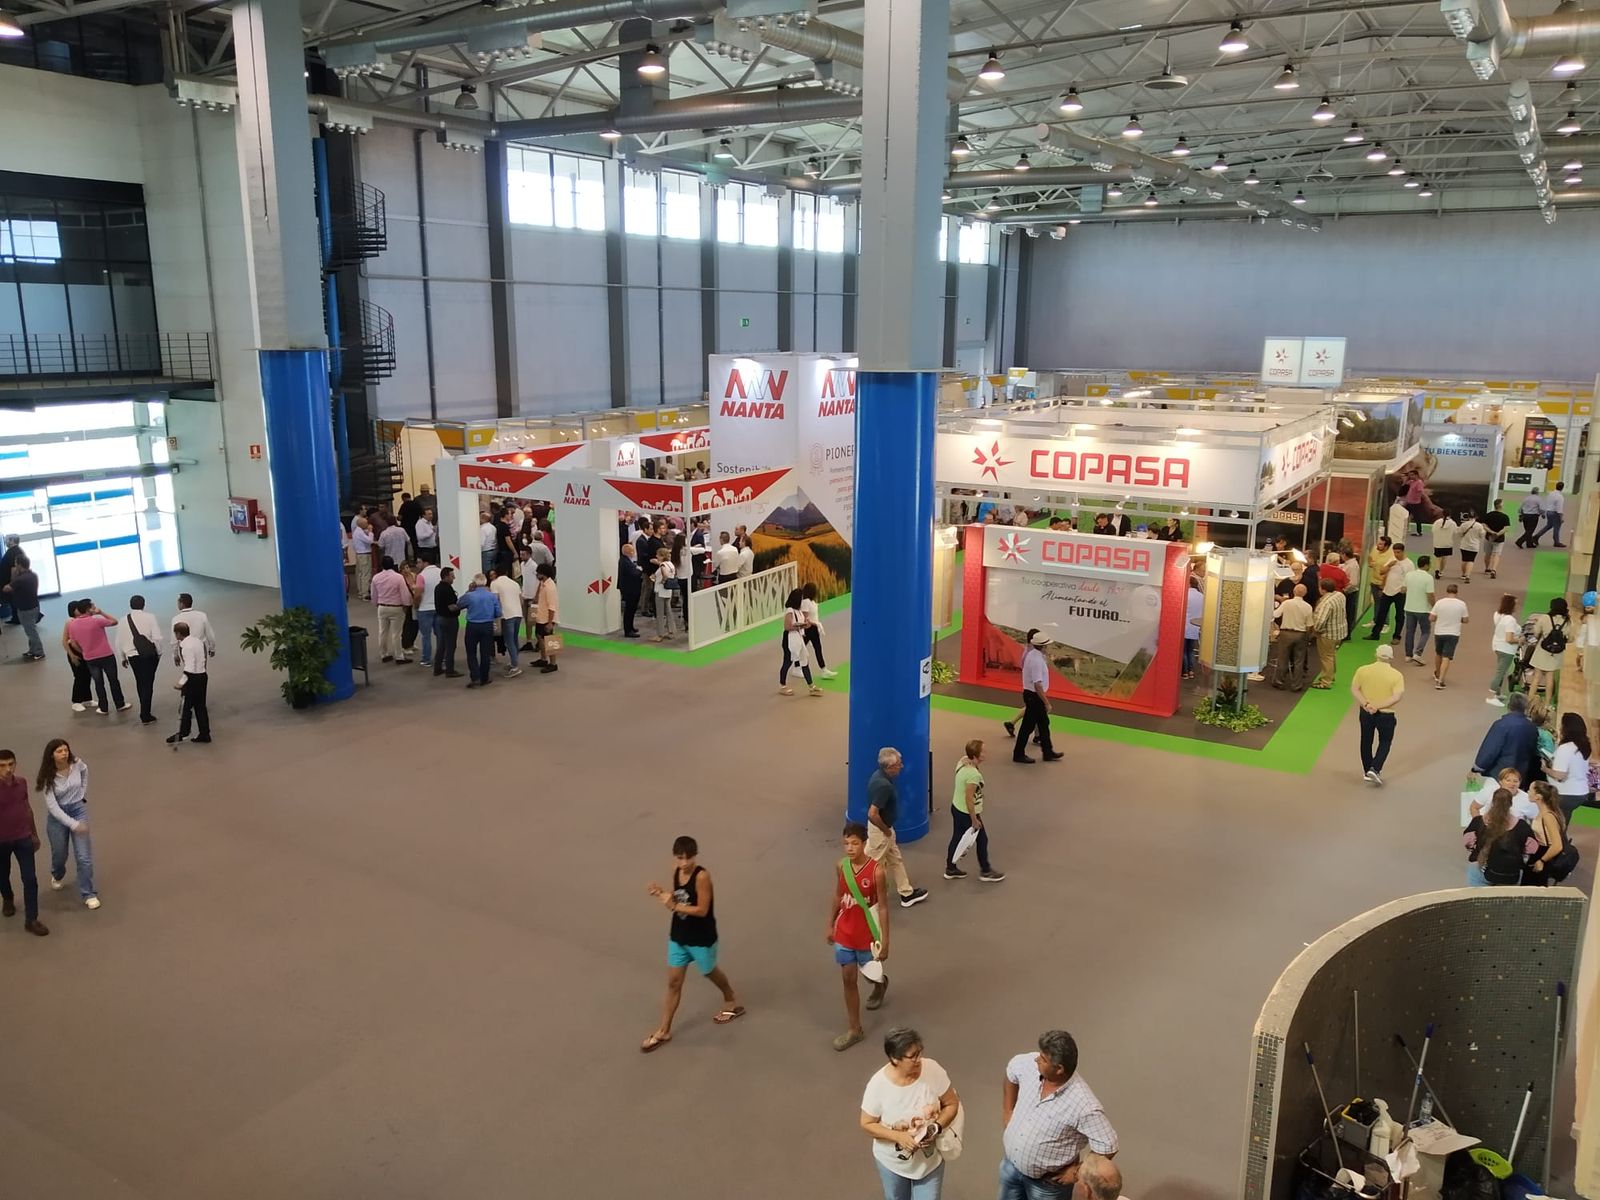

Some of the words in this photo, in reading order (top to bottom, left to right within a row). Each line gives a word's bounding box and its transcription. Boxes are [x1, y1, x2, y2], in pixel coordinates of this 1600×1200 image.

[720, 400, 784, 419] NANTA
[818, 398, 855, 417] NANTA
[1436, 448, 1487, 457] BIENESTAR.
[616, 459, 635, 468] NANTA
[1030, 449, 1190, 488] COPASA
[563, 496, 590, 507] NANTA
[1041, 540, 1150, 572] COPASA
[1031, 578, 1077, 591] cooperativa
[1078, 579, 1100, 593] desde
[1040, 590, 1098, 604] Alimentando
[1069, 606, 1131, 623] FUTURO...
